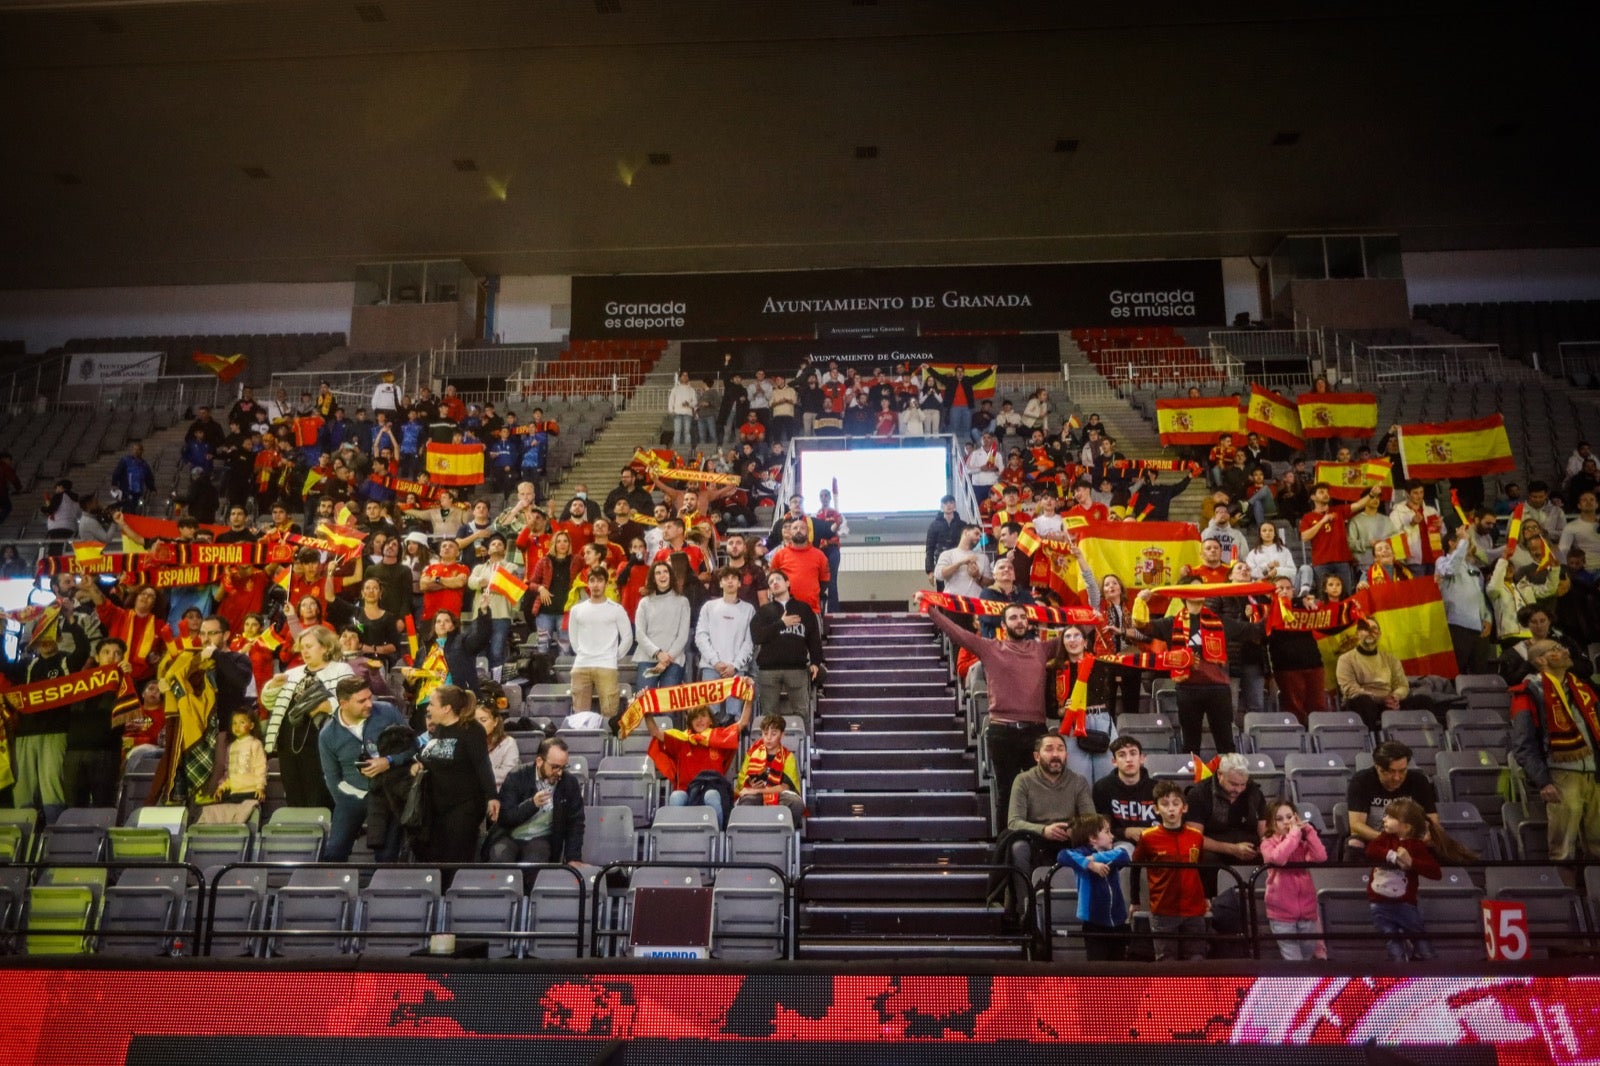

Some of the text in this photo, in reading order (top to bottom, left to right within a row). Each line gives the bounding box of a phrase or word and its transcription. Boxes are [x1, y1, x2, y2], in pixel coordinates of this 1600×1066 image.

[762, 291, 1032, 313] AYUNTAMIENTO DE GRANADA
[1109, 289, 1194, 304] Granada
[605, 300, 686, 315] Granada
[1110, 302, 1195, 318] es música
[605, 316, 685, 329] es deporte
[808, 351, 934, 362] AYUNTAMIENTO DE GRANADA
[199, 544, 243, 563] ESPAÑA
[157, 566, 200, 587] ESPAÑA
[29, 669, 120, 706] ESPAÑA
